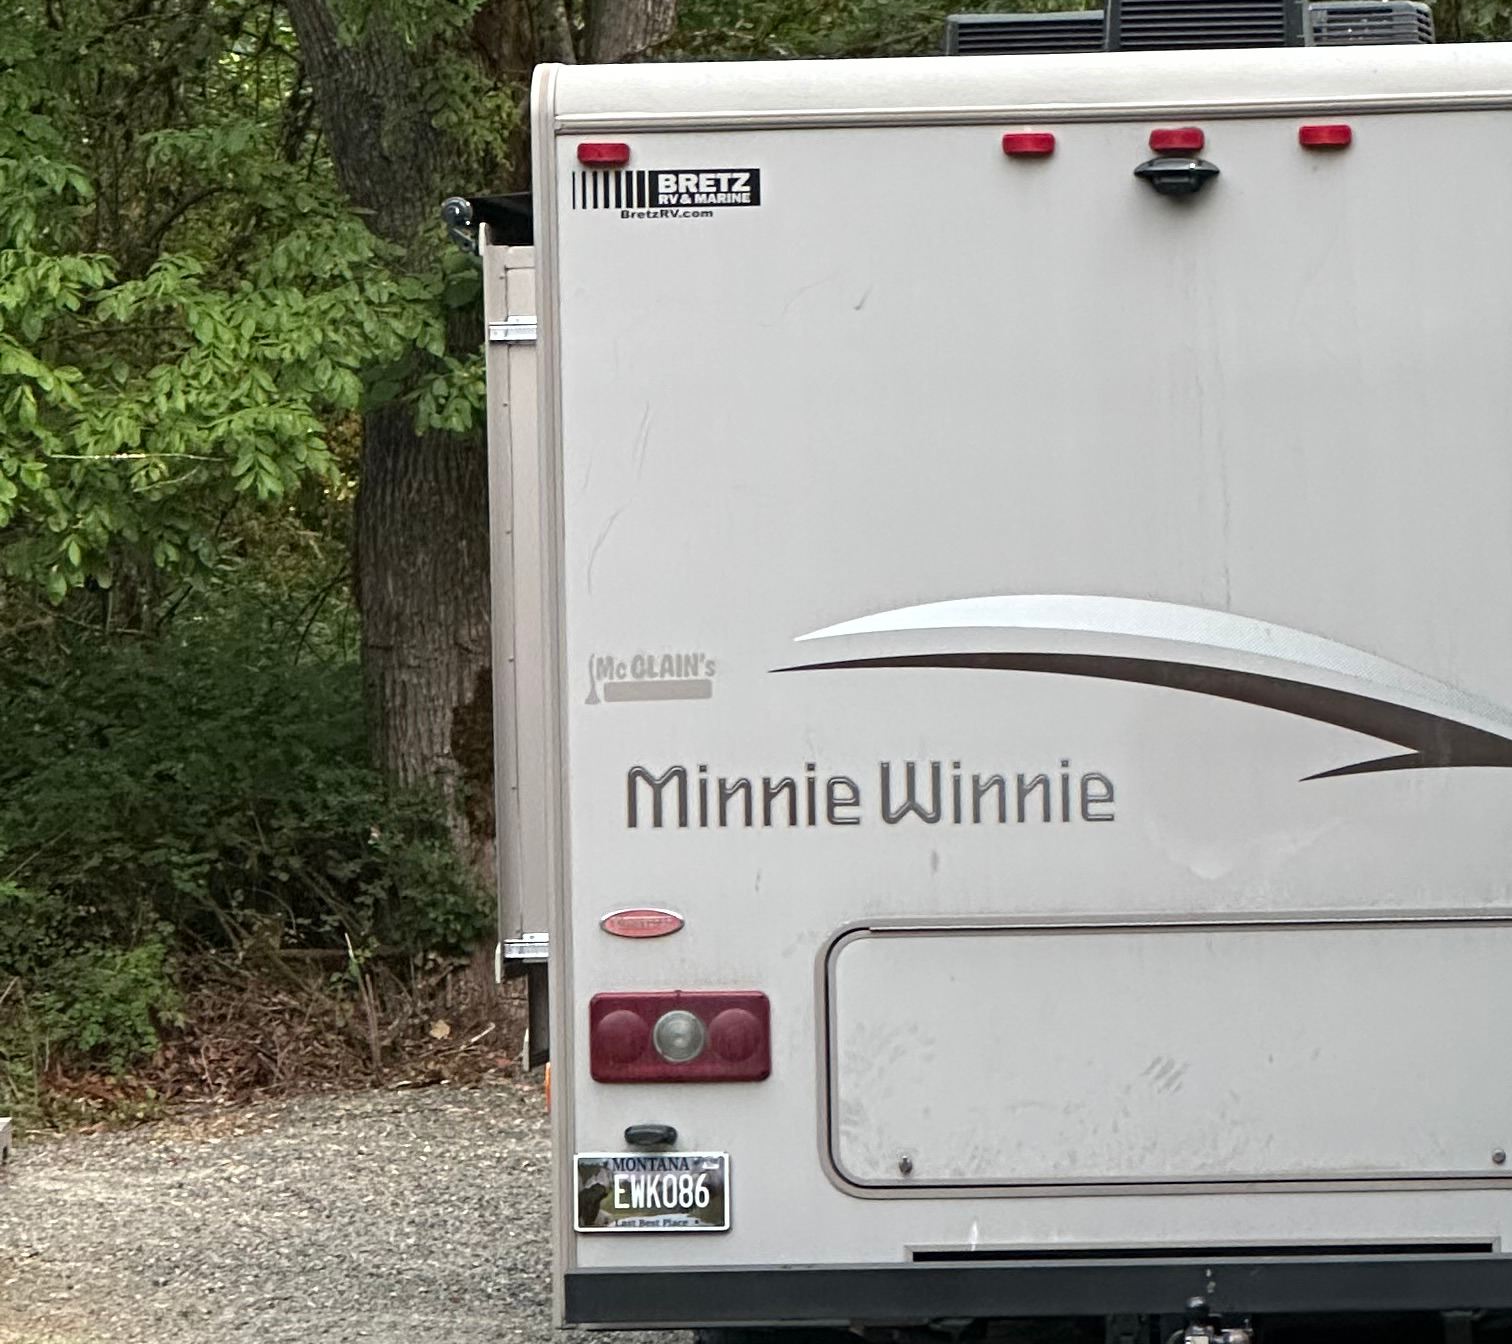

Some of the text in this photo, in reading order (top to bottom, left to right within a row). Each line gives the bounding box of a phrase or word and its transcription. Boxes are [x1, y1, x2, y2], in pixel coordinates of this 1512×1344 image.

[657, 172, 751, 193] BRETZ
[658, 192, 751, 205] RV & MARINE
[620, 209, 713, 219] BretzRV.com
[627, 759, 1115, 828] Minnie Winnie
[612, 1158, 690, 1172] MONTANA
[614, 1173, 710, 1209] EWK086
[614, 1217, 688, 1228] Last Best Place
